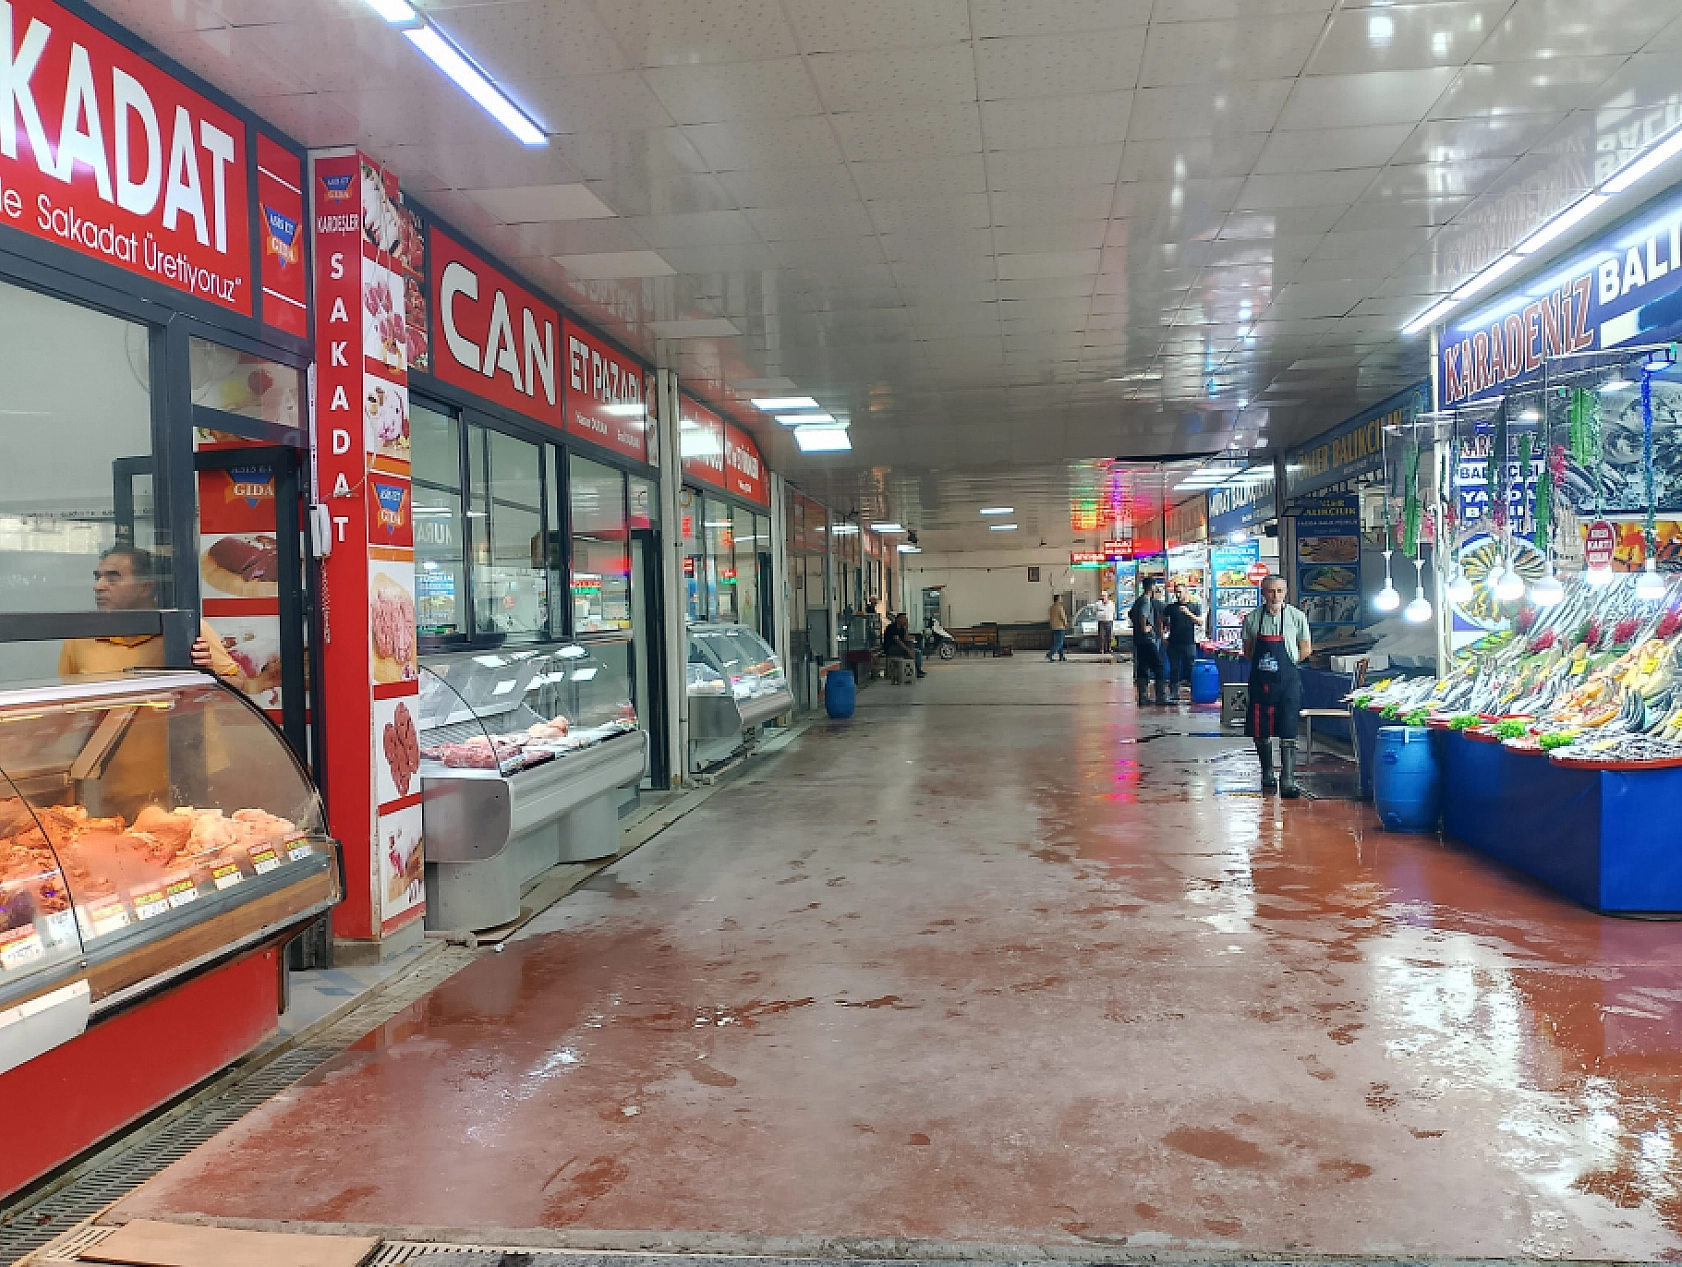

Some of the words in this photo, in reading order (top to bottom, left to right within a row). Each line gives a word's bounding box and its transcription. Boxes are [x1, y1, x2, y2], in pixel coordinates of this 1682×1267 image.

[0, 0, 235, 254] KADAT
[36, 193, 138, 263] Sakadat
[143, 231, 242, 303] Üretiyoruz"
[329, 252, 351, 542] SAKADAT
[440, 261, 556, 406] CAN
[569, 335, 589, 395] ET
[1443, 272, 1594, 405] KARADENİZ
[233, 483, 275, 497] GIDA
